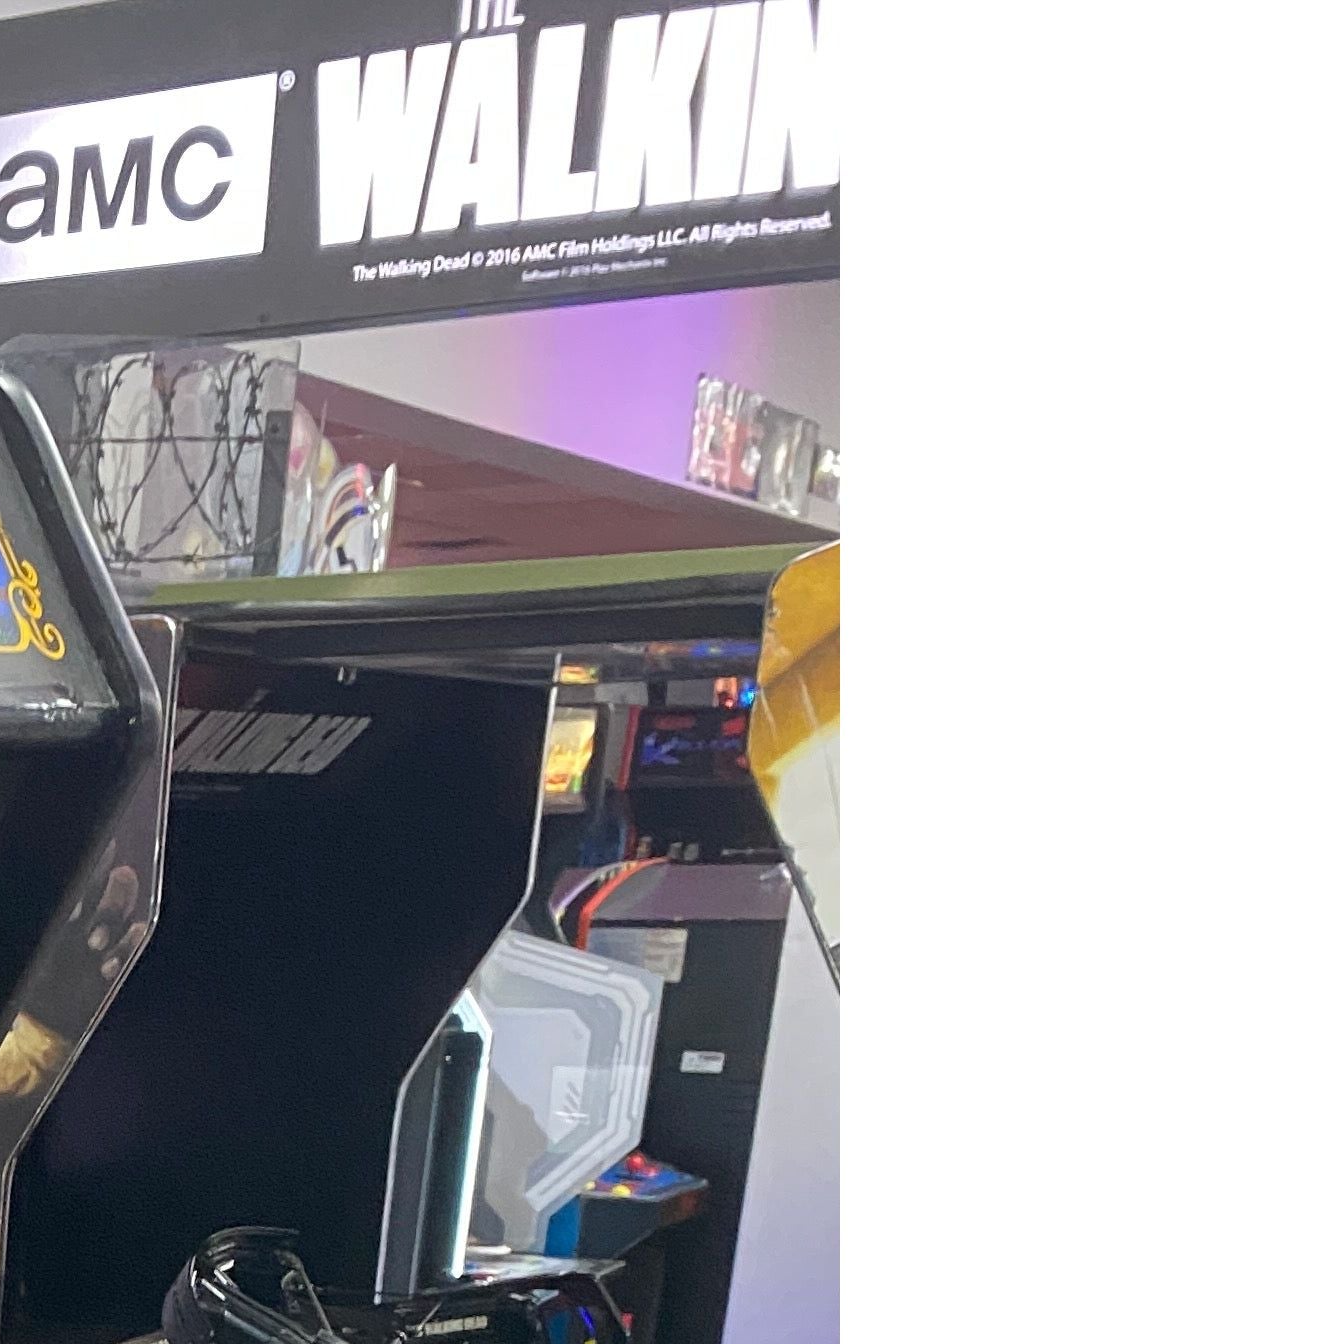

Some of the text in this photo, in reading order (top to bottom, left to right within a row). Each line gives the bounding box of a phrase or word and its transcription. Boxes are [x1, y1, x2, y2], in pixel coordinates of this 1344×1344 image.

[353, 264, 377, 281] The
[379, 258, 431, 278] Walking
[434, 250, 470, 271] Dead
[486, 249, 521, 267] 2016
[522, 242, 557, 262] AMC
[559, 239, 589, 258] Film
[591, 234, 656, 254] Holdings
[689, 225, 710, 244] All
[711, 220, 758, 244] Rights
